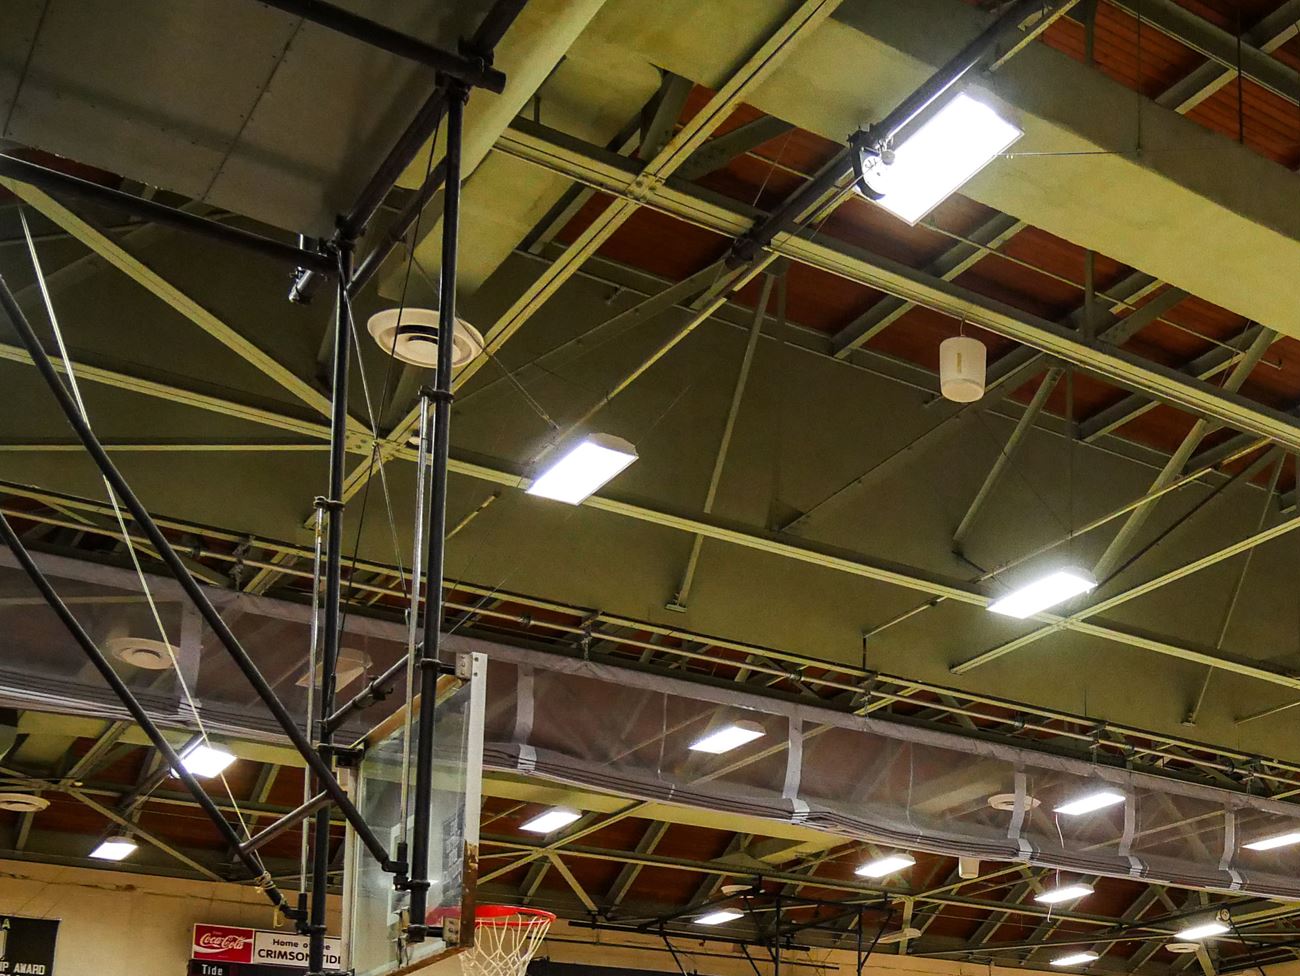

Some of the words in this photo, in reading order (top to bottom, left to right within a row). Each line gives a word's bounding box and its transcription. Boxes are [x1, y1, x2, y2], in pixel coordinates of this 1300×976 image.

[200, 932, 248, 950] Coca-Cola
[272, 938, 299, 948] Home
[13, 963, 46, 975] AWARD
[202, 964, 223, 976] Tide
